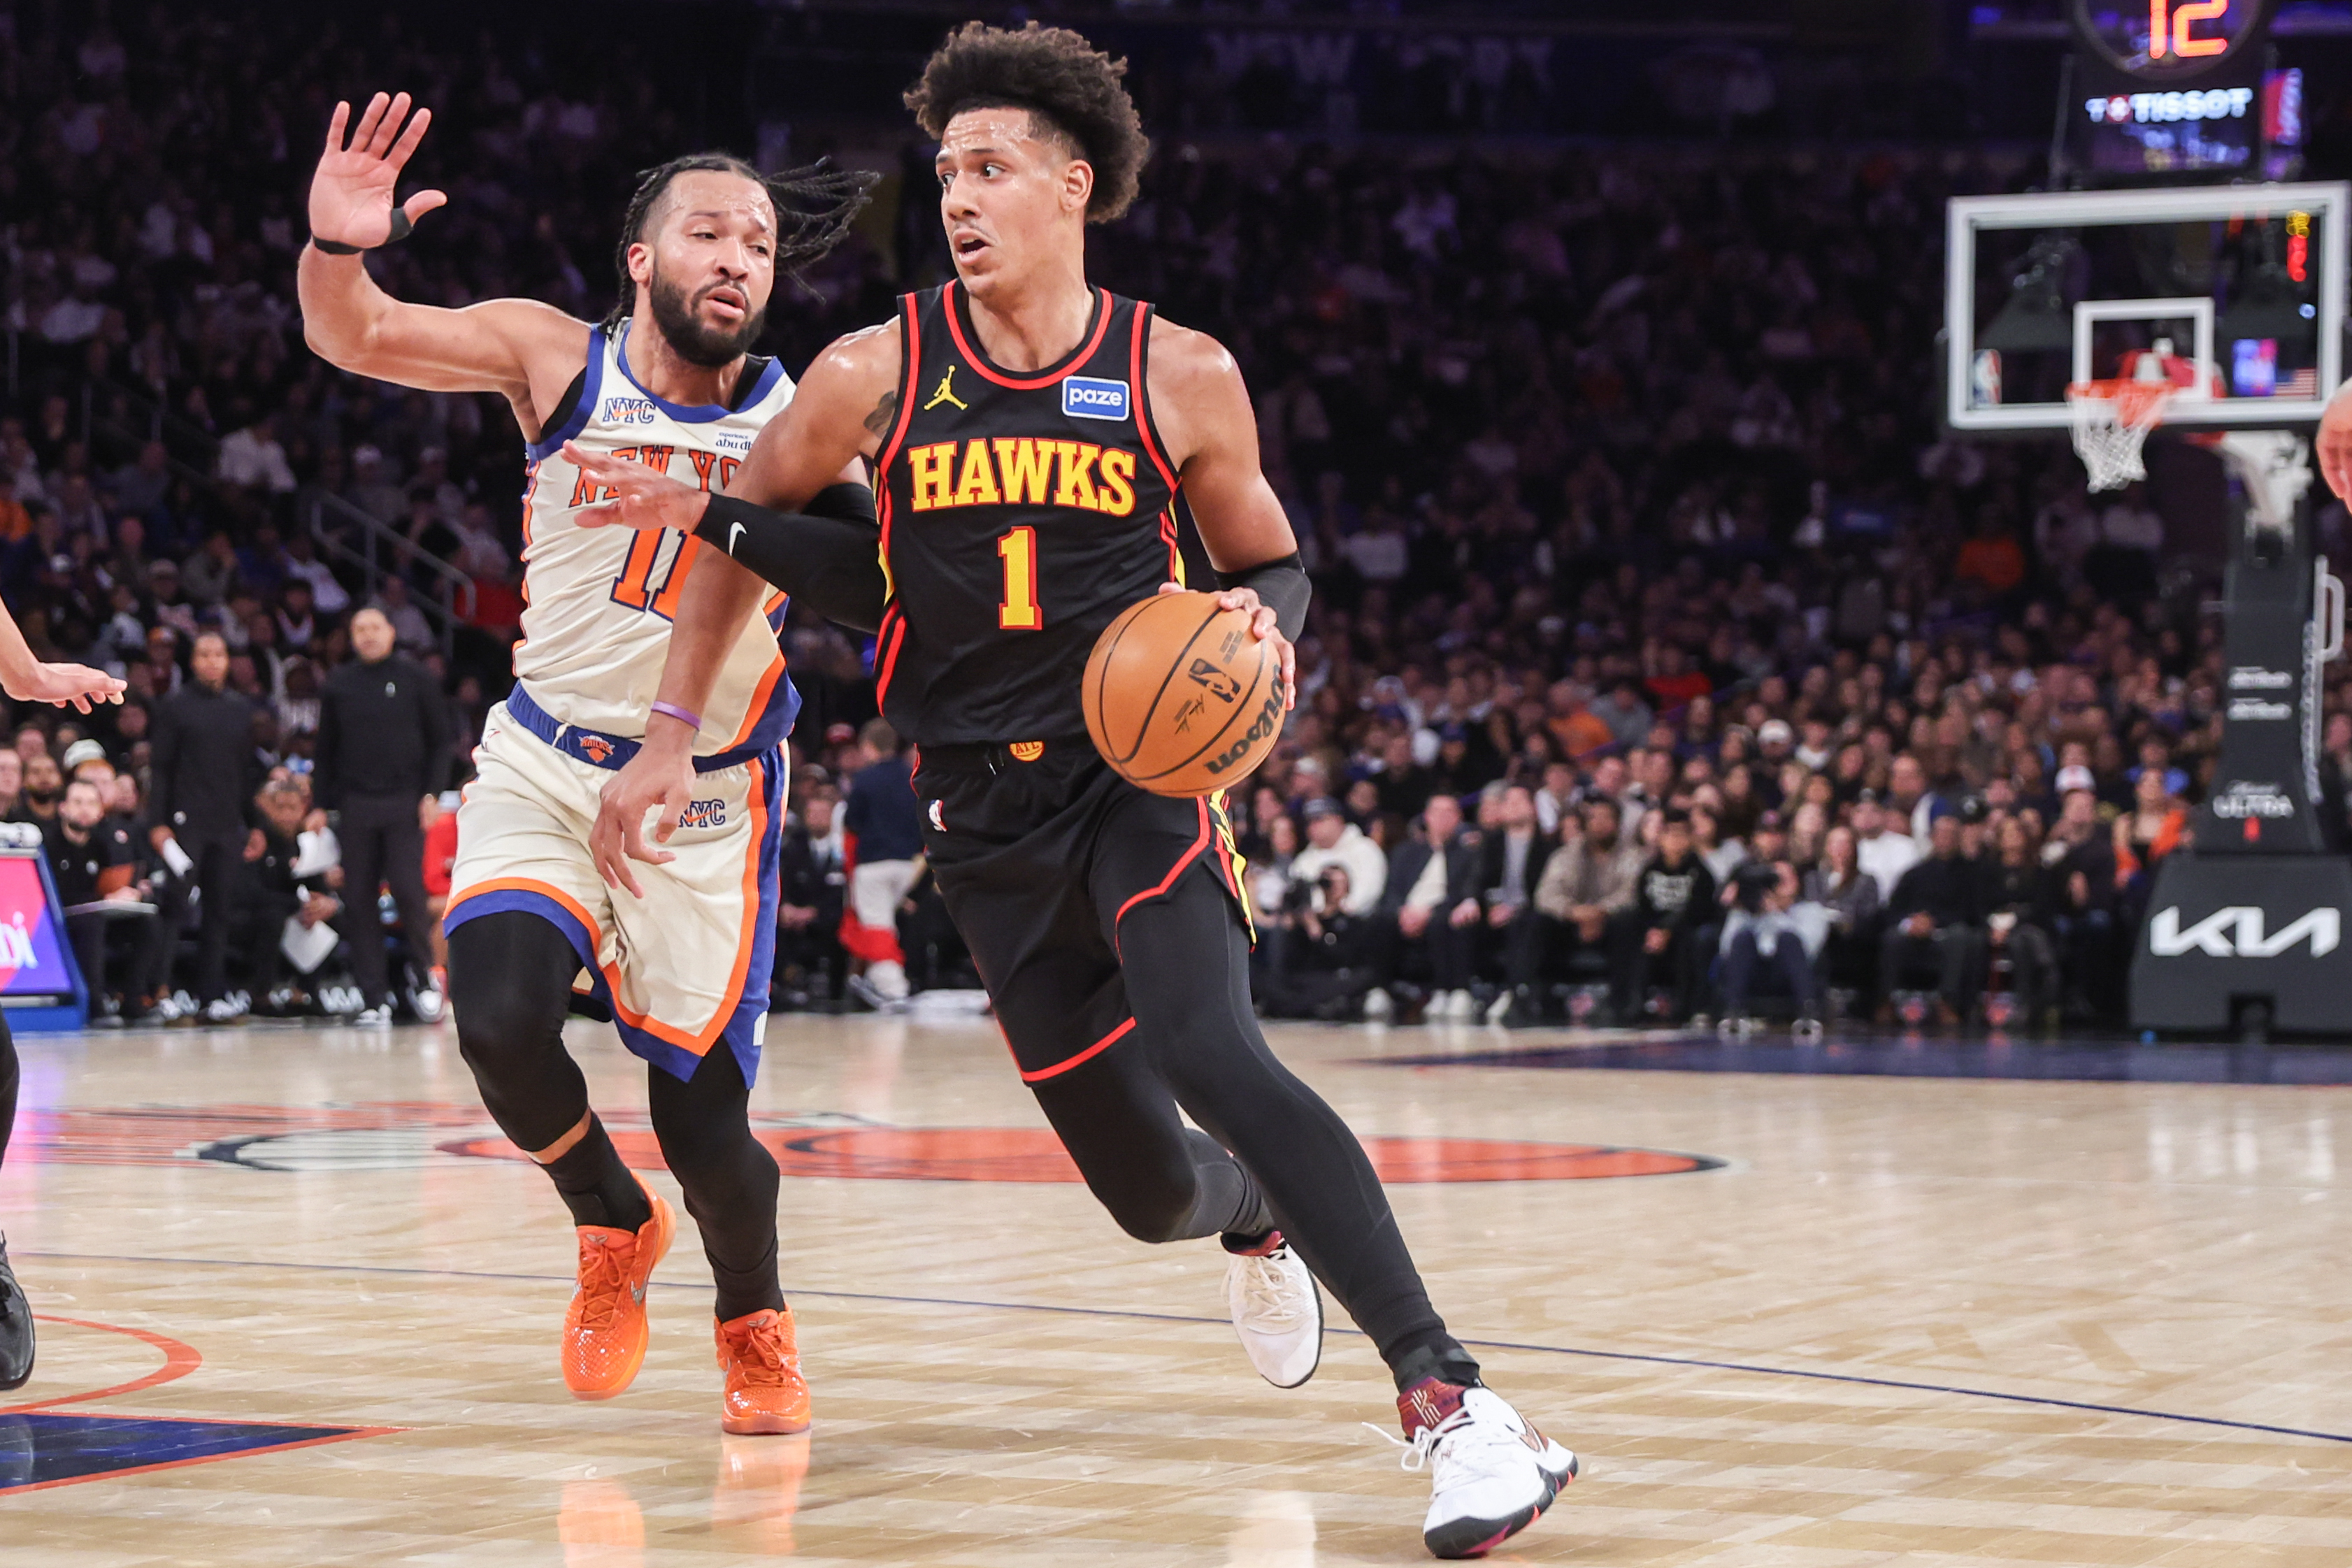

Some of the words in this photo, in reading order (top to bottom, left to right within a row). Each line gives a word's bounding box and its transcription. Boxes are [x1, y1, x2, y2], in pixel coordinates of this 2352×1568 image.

[2130, 87, 2253, 122] TISSOT
[603, 398, 656, 424] NYC
[1069, 387, 1123, 407] paze
[716, 438, 738, 449] abu
[908, 437, 1136, 517] HAWKS
[998, 526, 1042, 631] 1
[678, 798, 726, 828] NYC
